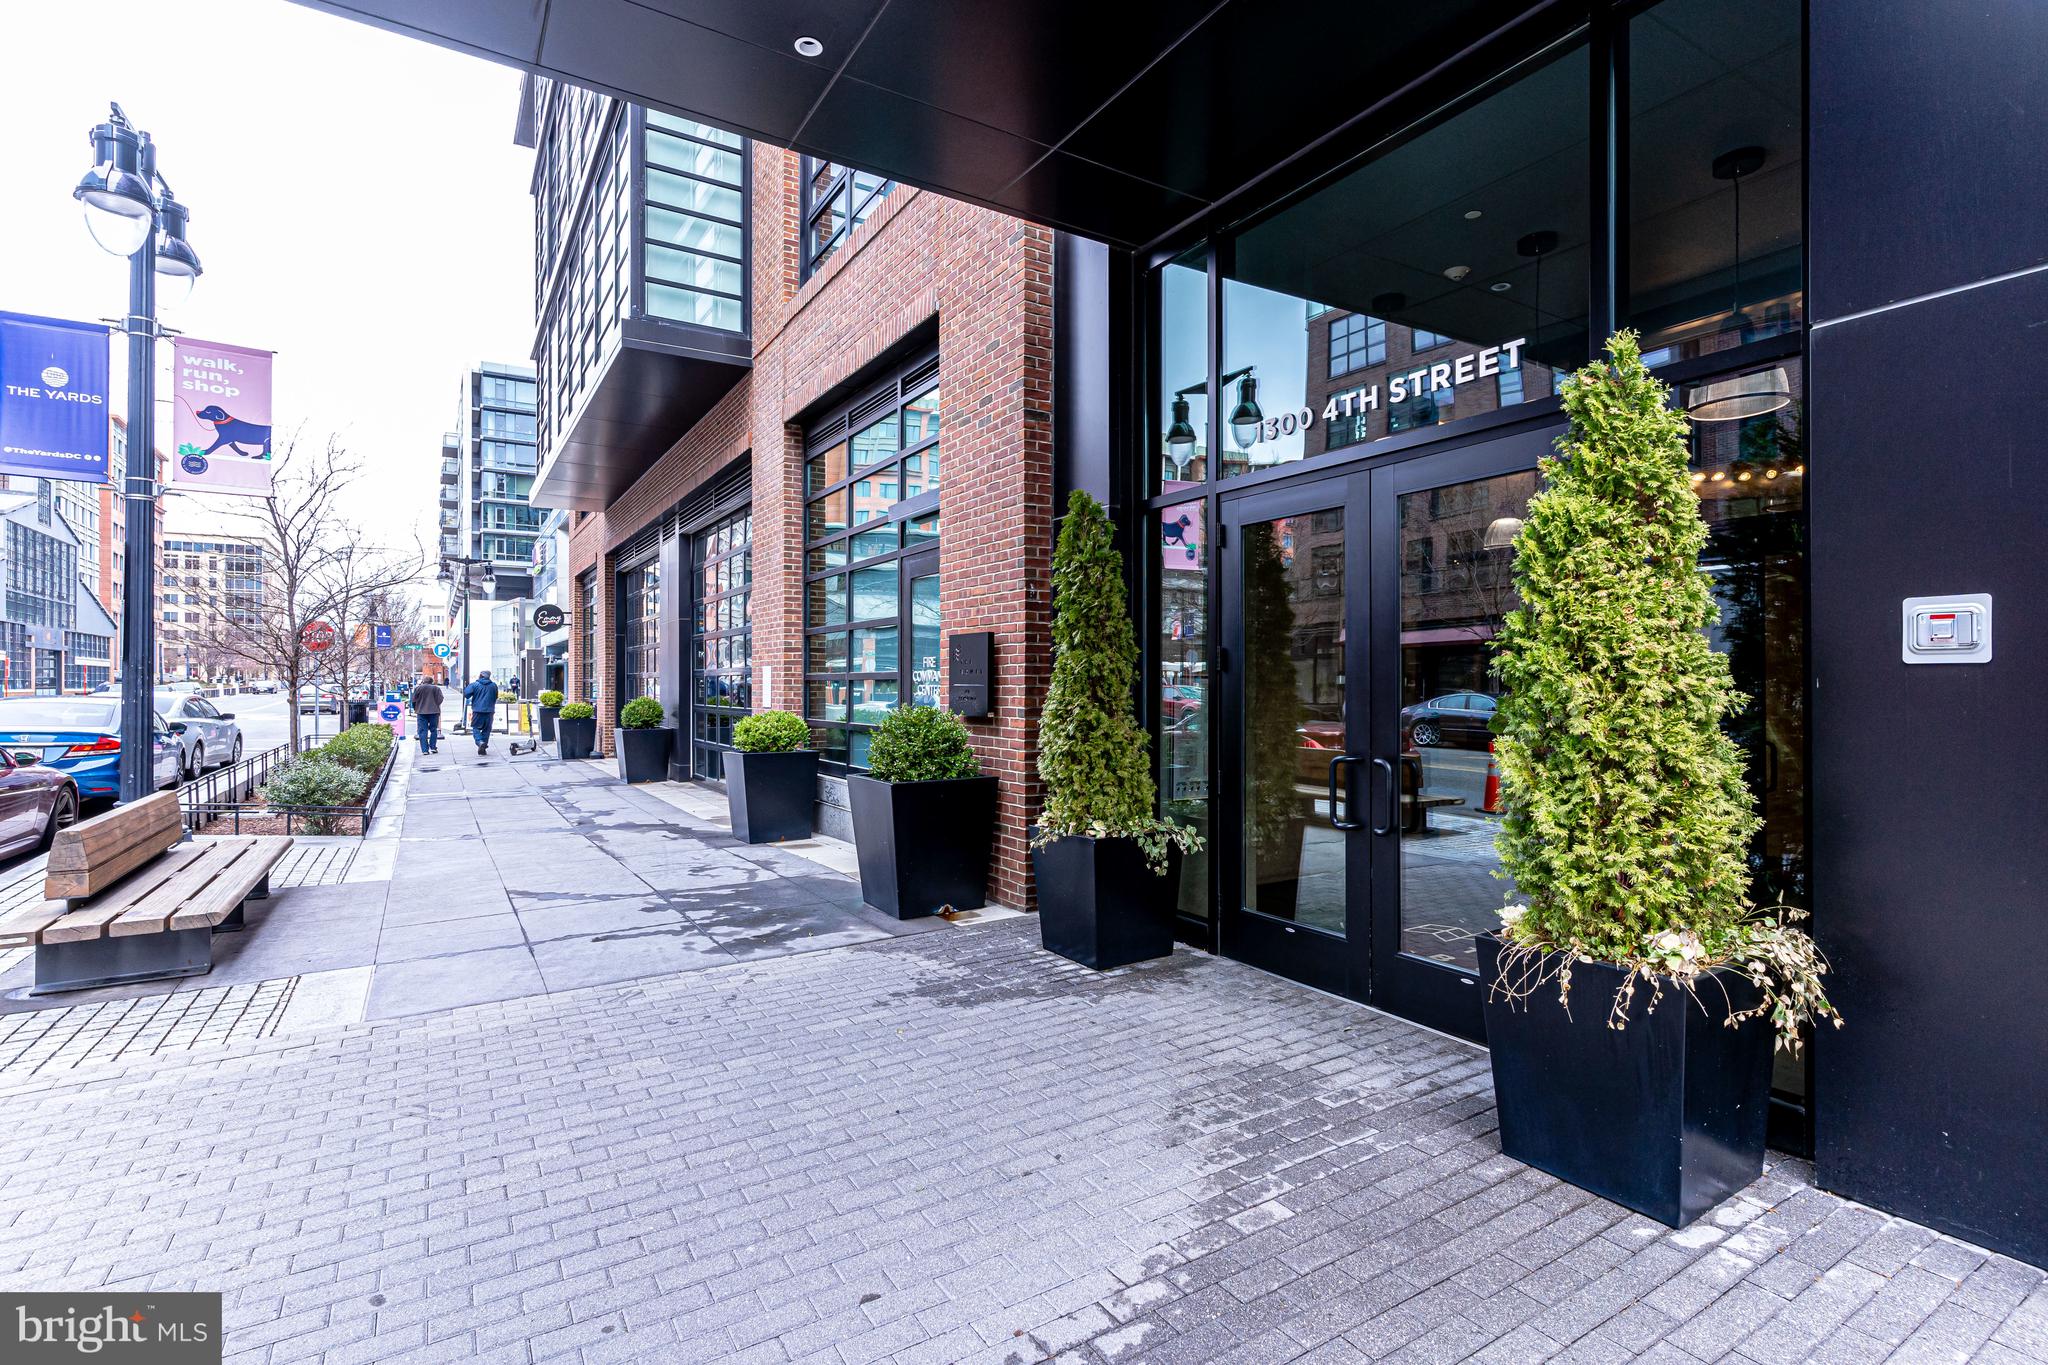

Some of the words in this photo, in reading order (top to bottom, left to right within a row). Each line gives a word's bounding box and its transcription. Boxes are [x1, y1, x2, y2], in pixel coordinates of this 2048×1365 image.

[182, 355, 245, 375] walk,
[182, 367, 230, 386] run,
[6, 385, 41, 398] THE
[44, 389, 103, 405] YARDS
[181, 379, 241, 398] shop
[1254, 406, 1315, 443] 1300
[1322, 384, 1379, 421] 4TH
[1388, 337, 1526, 404] STREET
[3, 446, 82, 460] @TheYardsDC
[437, 645, 449, 656] P
